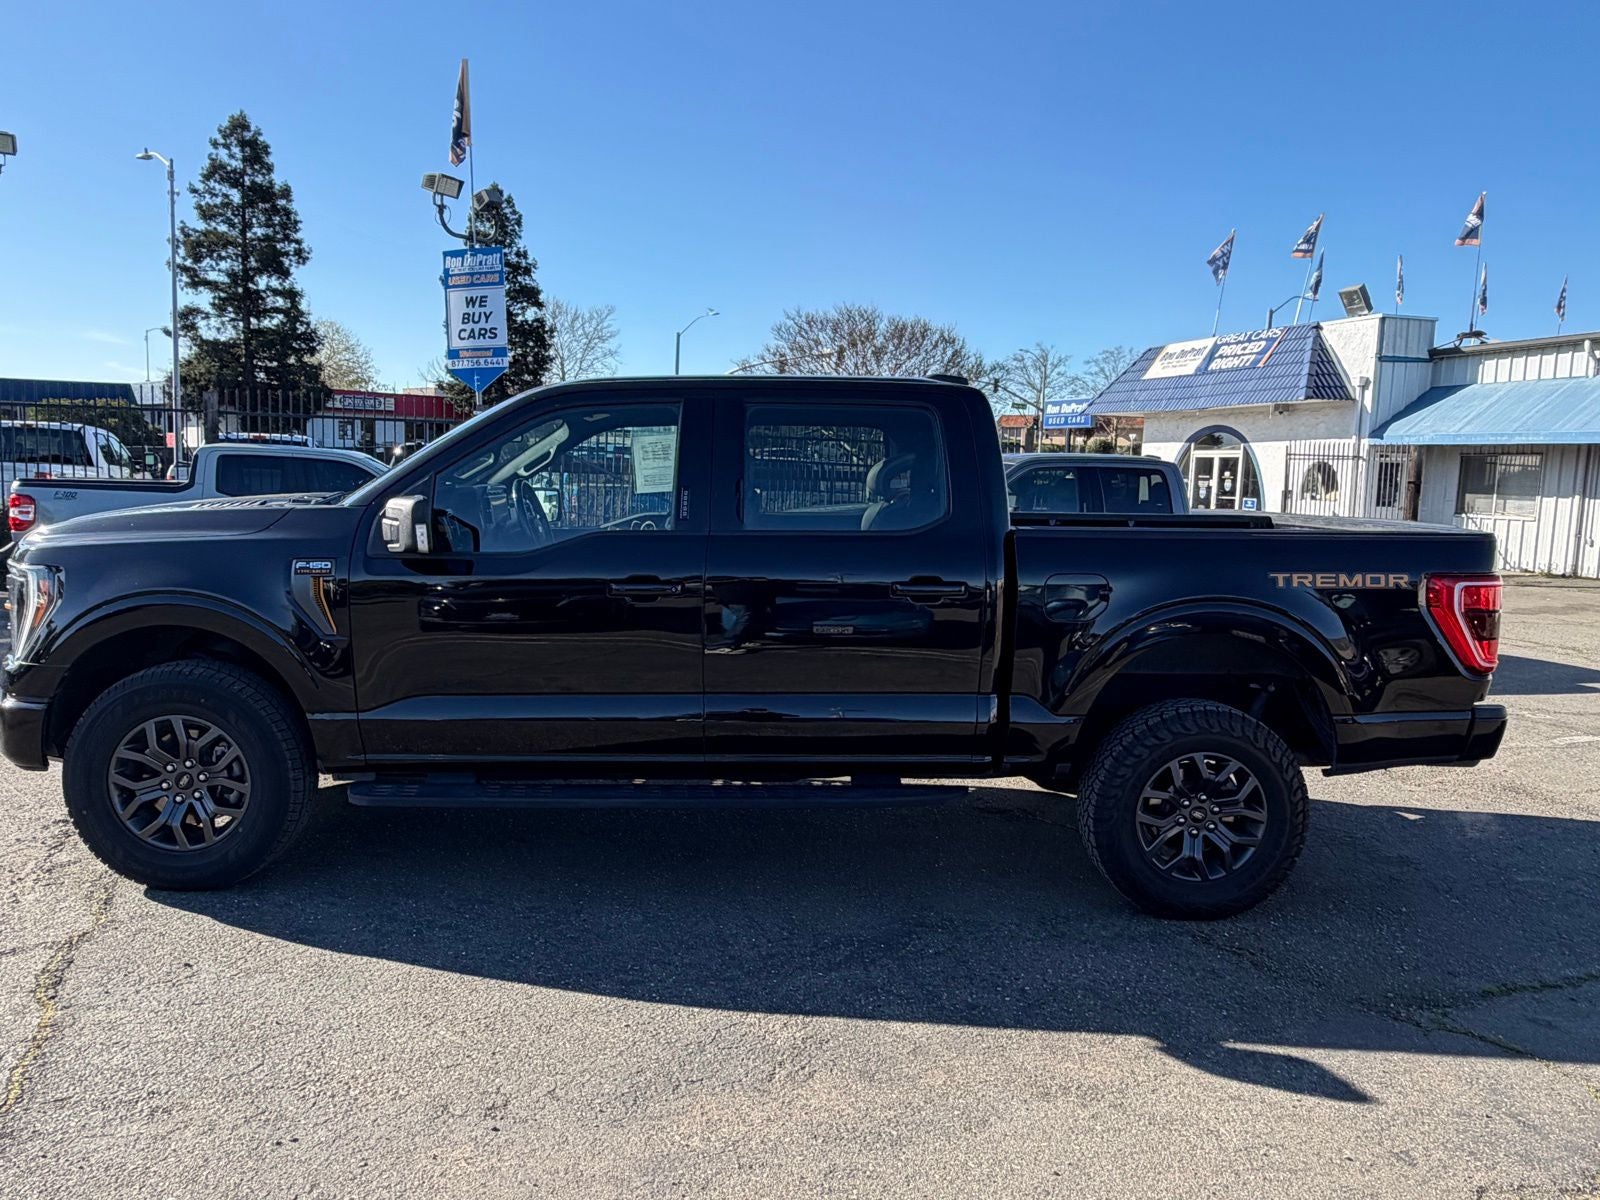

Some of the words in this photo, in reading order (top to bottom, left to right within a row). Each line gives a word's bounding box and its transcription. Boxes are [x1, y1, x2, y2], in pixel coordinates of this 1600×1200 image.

[445, 256, 462, 268] Ron
[463, 253, 501, 266] DuPratt
[472, 273, 500, 284] CARS
[464, 295, 489, 309] WE
[461, 311, 493, 325] BUY
[457, 327, 498, 341] CARS
[1216, 331, 1252, 345] GREAT
[1251, 327, 1284, 341] CARS
[1214, 340, 1267, 358] PRICED
[1207, 354, 1256, 371] RIGHT!
[1048, 416, 1065, 425] USED
[1067, 415, 1086, 424] CARS
[295, 561, 332, 569] F-150
[1269, 573, 1411, 588] TREMOR
